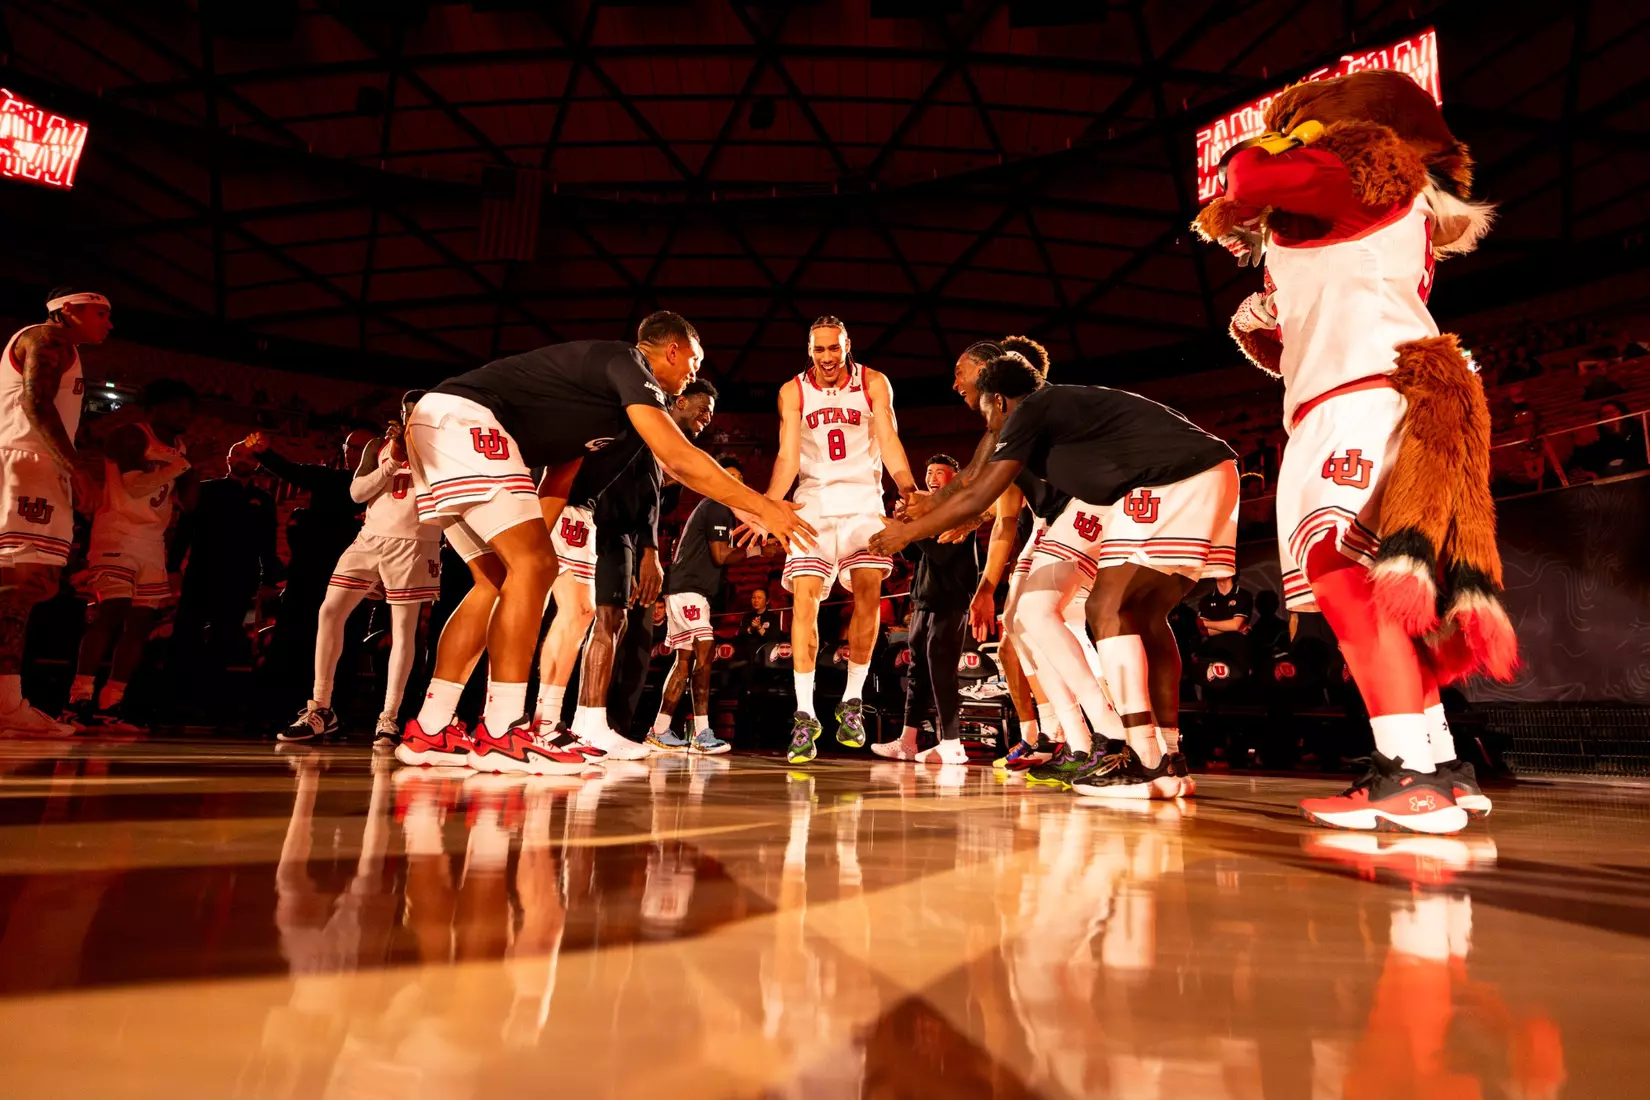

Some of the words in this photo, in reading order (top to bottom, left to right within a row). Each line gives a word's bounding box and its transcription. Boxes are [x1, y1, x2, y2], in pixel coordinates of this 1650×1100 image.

[805, 407, 861, 429] UTAH
[827, 428, 846, 461] 8
[966, 655, 978, 666] U
[1214, 665, 1225, 676] U
